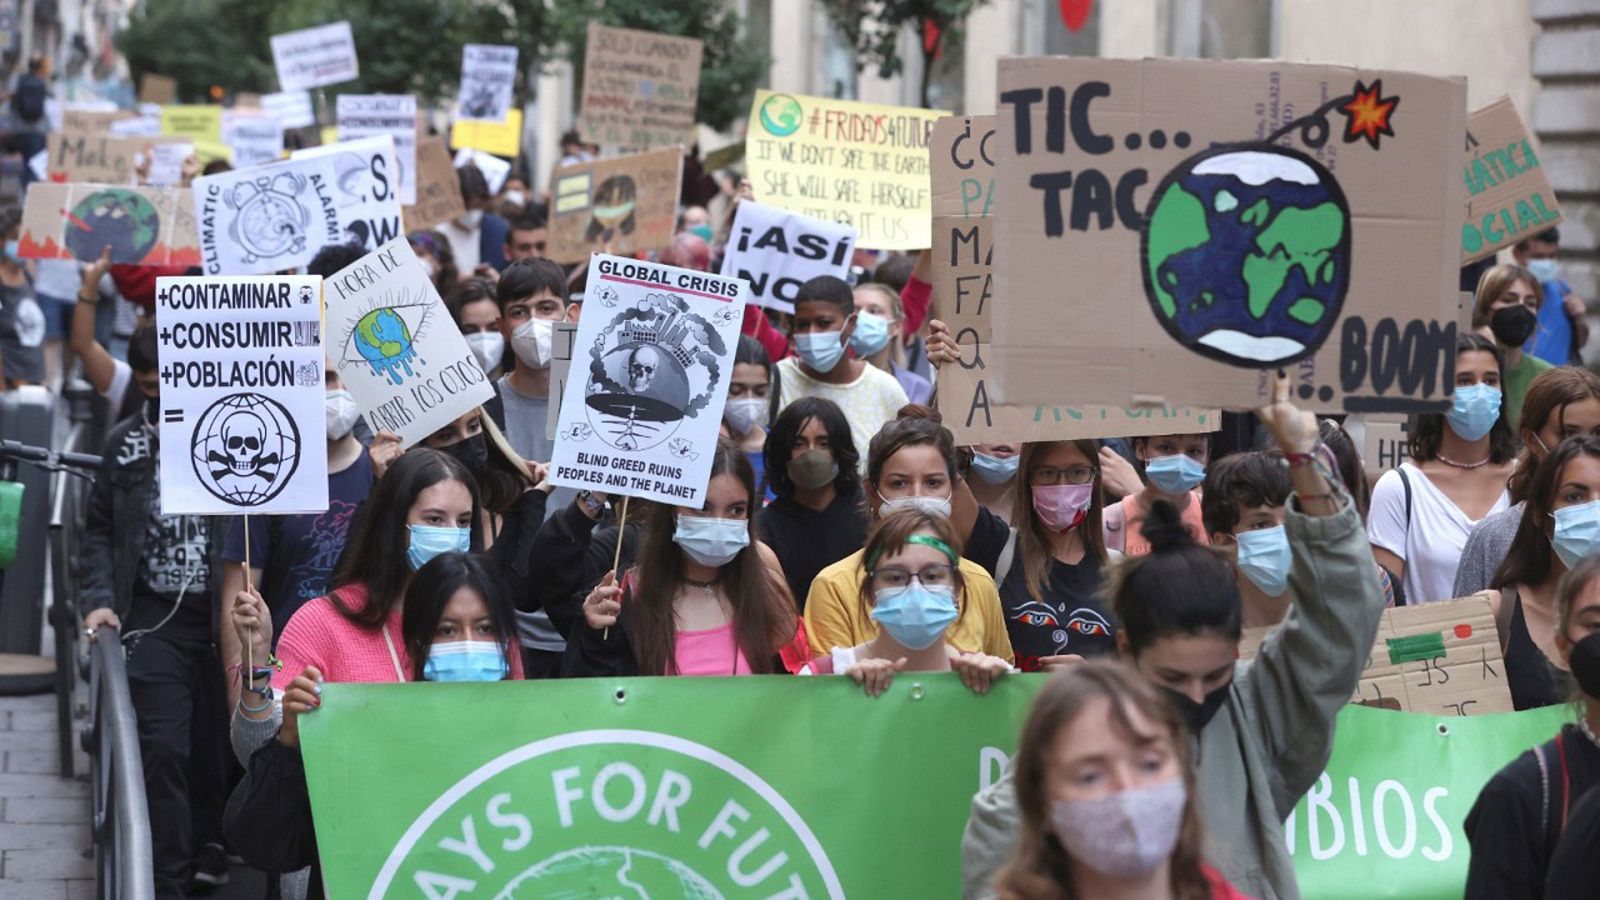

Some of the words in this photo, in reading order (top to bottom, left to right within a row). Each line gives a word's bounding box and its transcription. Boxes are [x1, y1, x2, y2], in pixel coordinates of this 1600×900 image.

[755, 139, 775, 160] IF
[800, 144, 835, 165] DON'T
[869, 151, 890, 171] THE
[309, 173, 339, 242] ALARM!
[764, 169, 793, 197] SHE
[797, 174, 829, 200] WILL
[870, 181, 929, 209] HERSELF
[1029, 168, 1149, 238] TAC
[202, 184, 221, 275] CLIMATIC
[333, 264, 381, 300] HORA
[378, 246, 403, 273] DE
[598, 260, 672, 285] GLOBAL
[678, 274, 739, 297] CRISIS
[158, 283, 292, 310] +CONTAMINAR
[160, 321, 293, 349] +CONSUMIR
[161, 353, 295, 388] +POBLACIÓN
[369, 395, 416, 432] ABRIR
[410, 378, 444, 413] LOS
[439, 354, 485, 395] OJOS
[557, 466, 606, 483] PEOPLES
[605, 473, 628, 487] AND
[630, 477, 651, 491] THE
[653, 480, 697, 499] PLANET
[577, 452, 609, 467] BLIND
[611, 457, 646, 473] GREED
[649, 463, 682, 479] RUINS
[551, 762, 692, 833] FOR
[1285, 770, 1454, 861] BIOS
